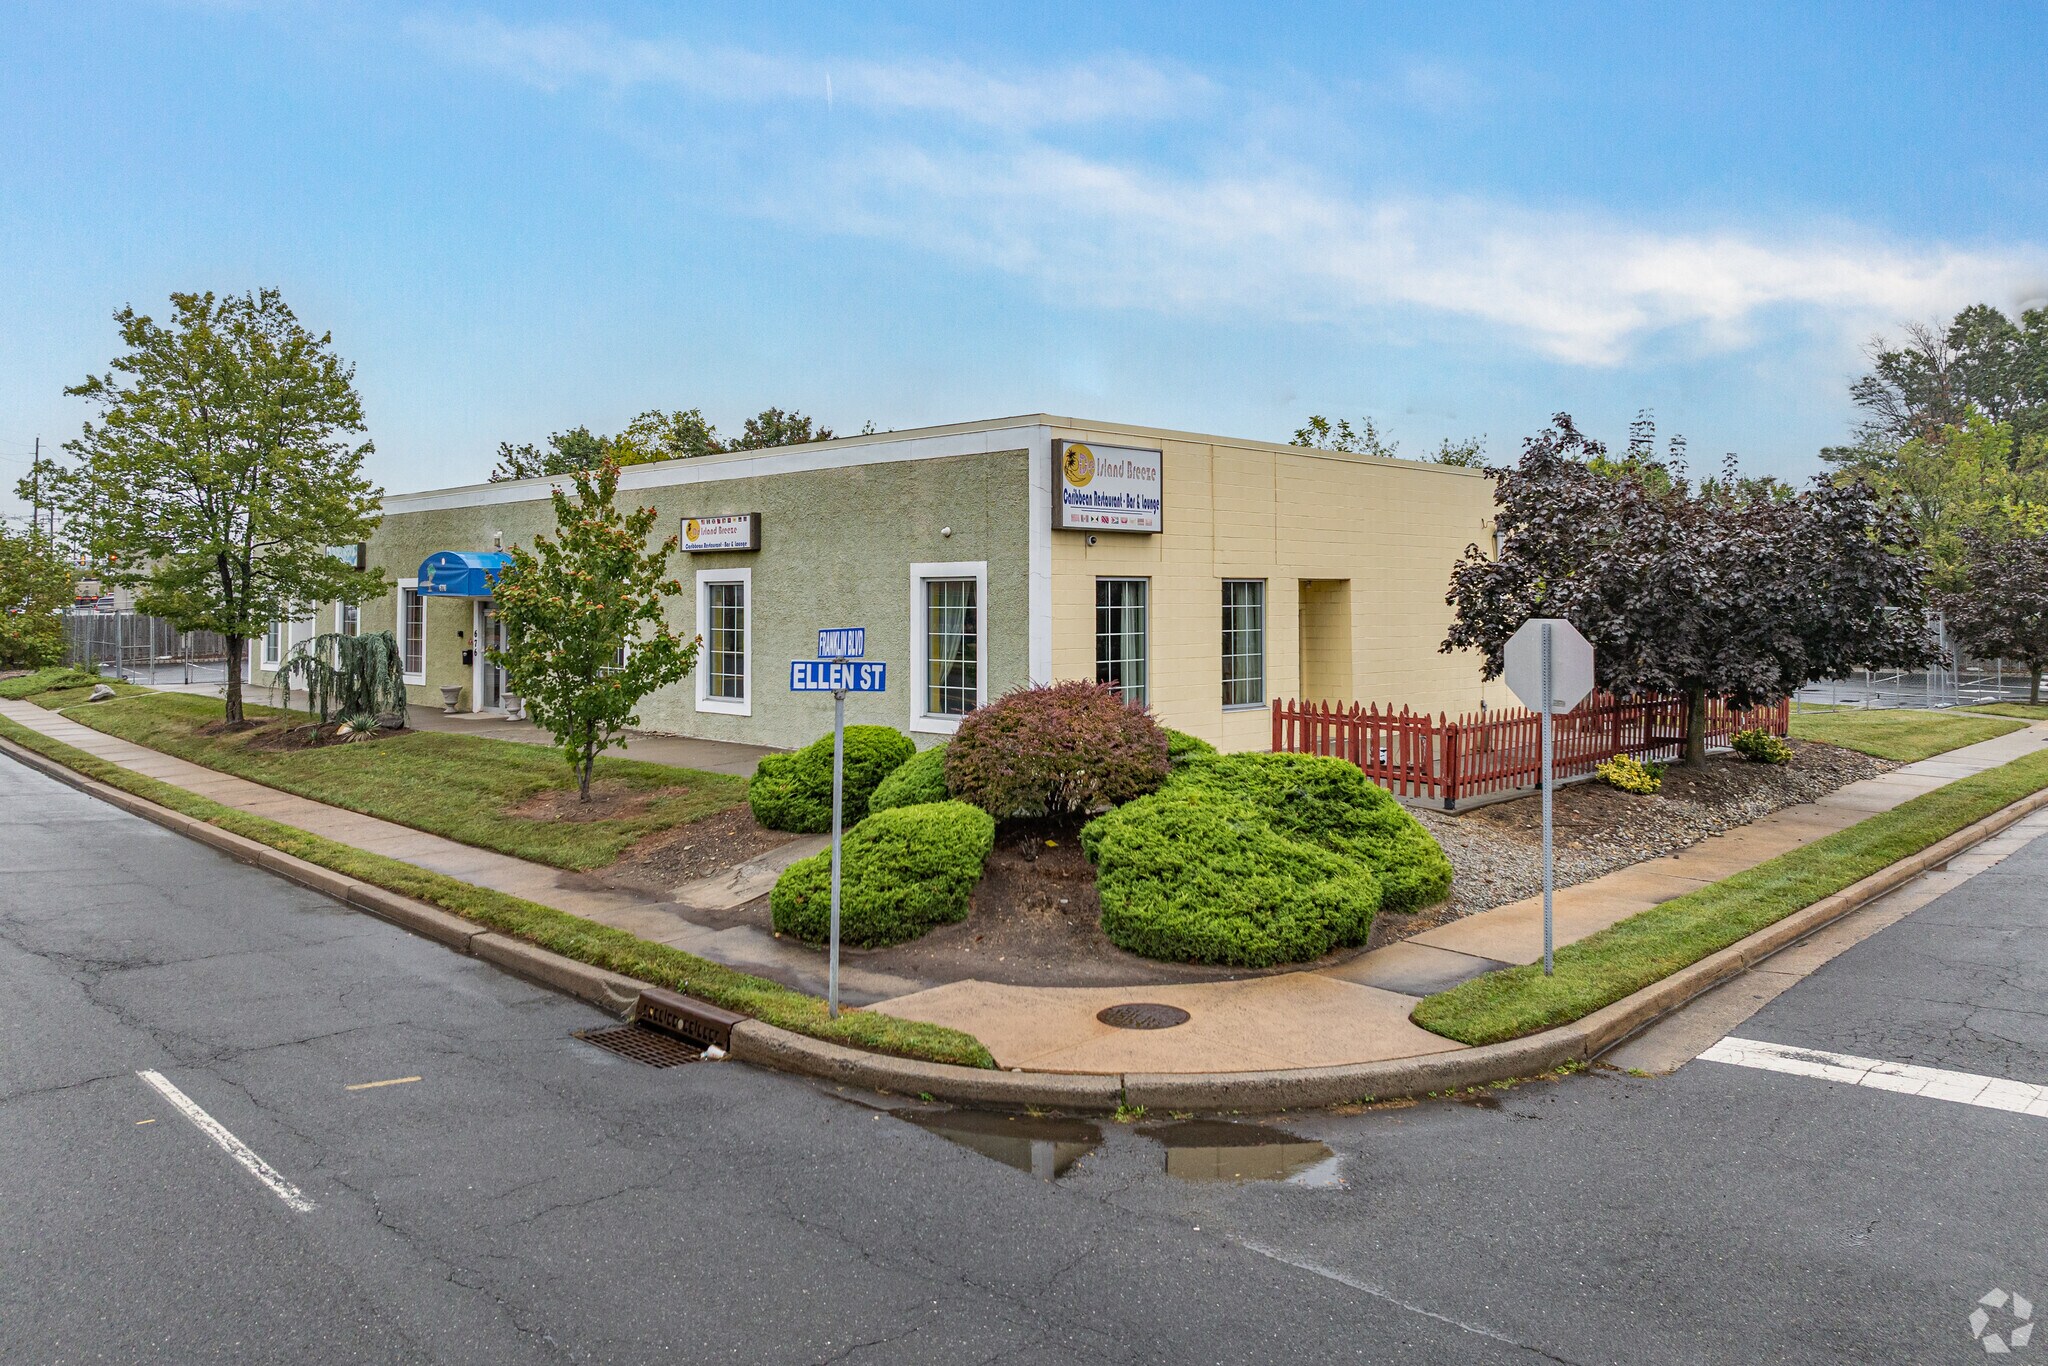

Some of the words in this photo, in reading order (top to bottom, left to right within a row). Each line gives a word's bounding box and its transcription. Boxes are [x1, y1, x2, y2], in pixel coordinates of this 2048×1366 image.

[1097, 458, 1124, 478] Island
[1127, 461, 1156, 481] Breeze
[1063, 488, 1092, 506] Caribbean
[1093, 490, 1122, 508] Restaurant
[1126, 493, 1135, 509] Bar
[1142, 494, 1160, 515] Lounge
[701, 526, 717, 535] Island
[719, 526, 737, 535] Breeze
[820, 631, 847, 656] FRANKLIN
[848, 630, 863, 656] BLVD
[793, 663, 854, 689] ELLEN
[860, 664, 883, 690] ST
